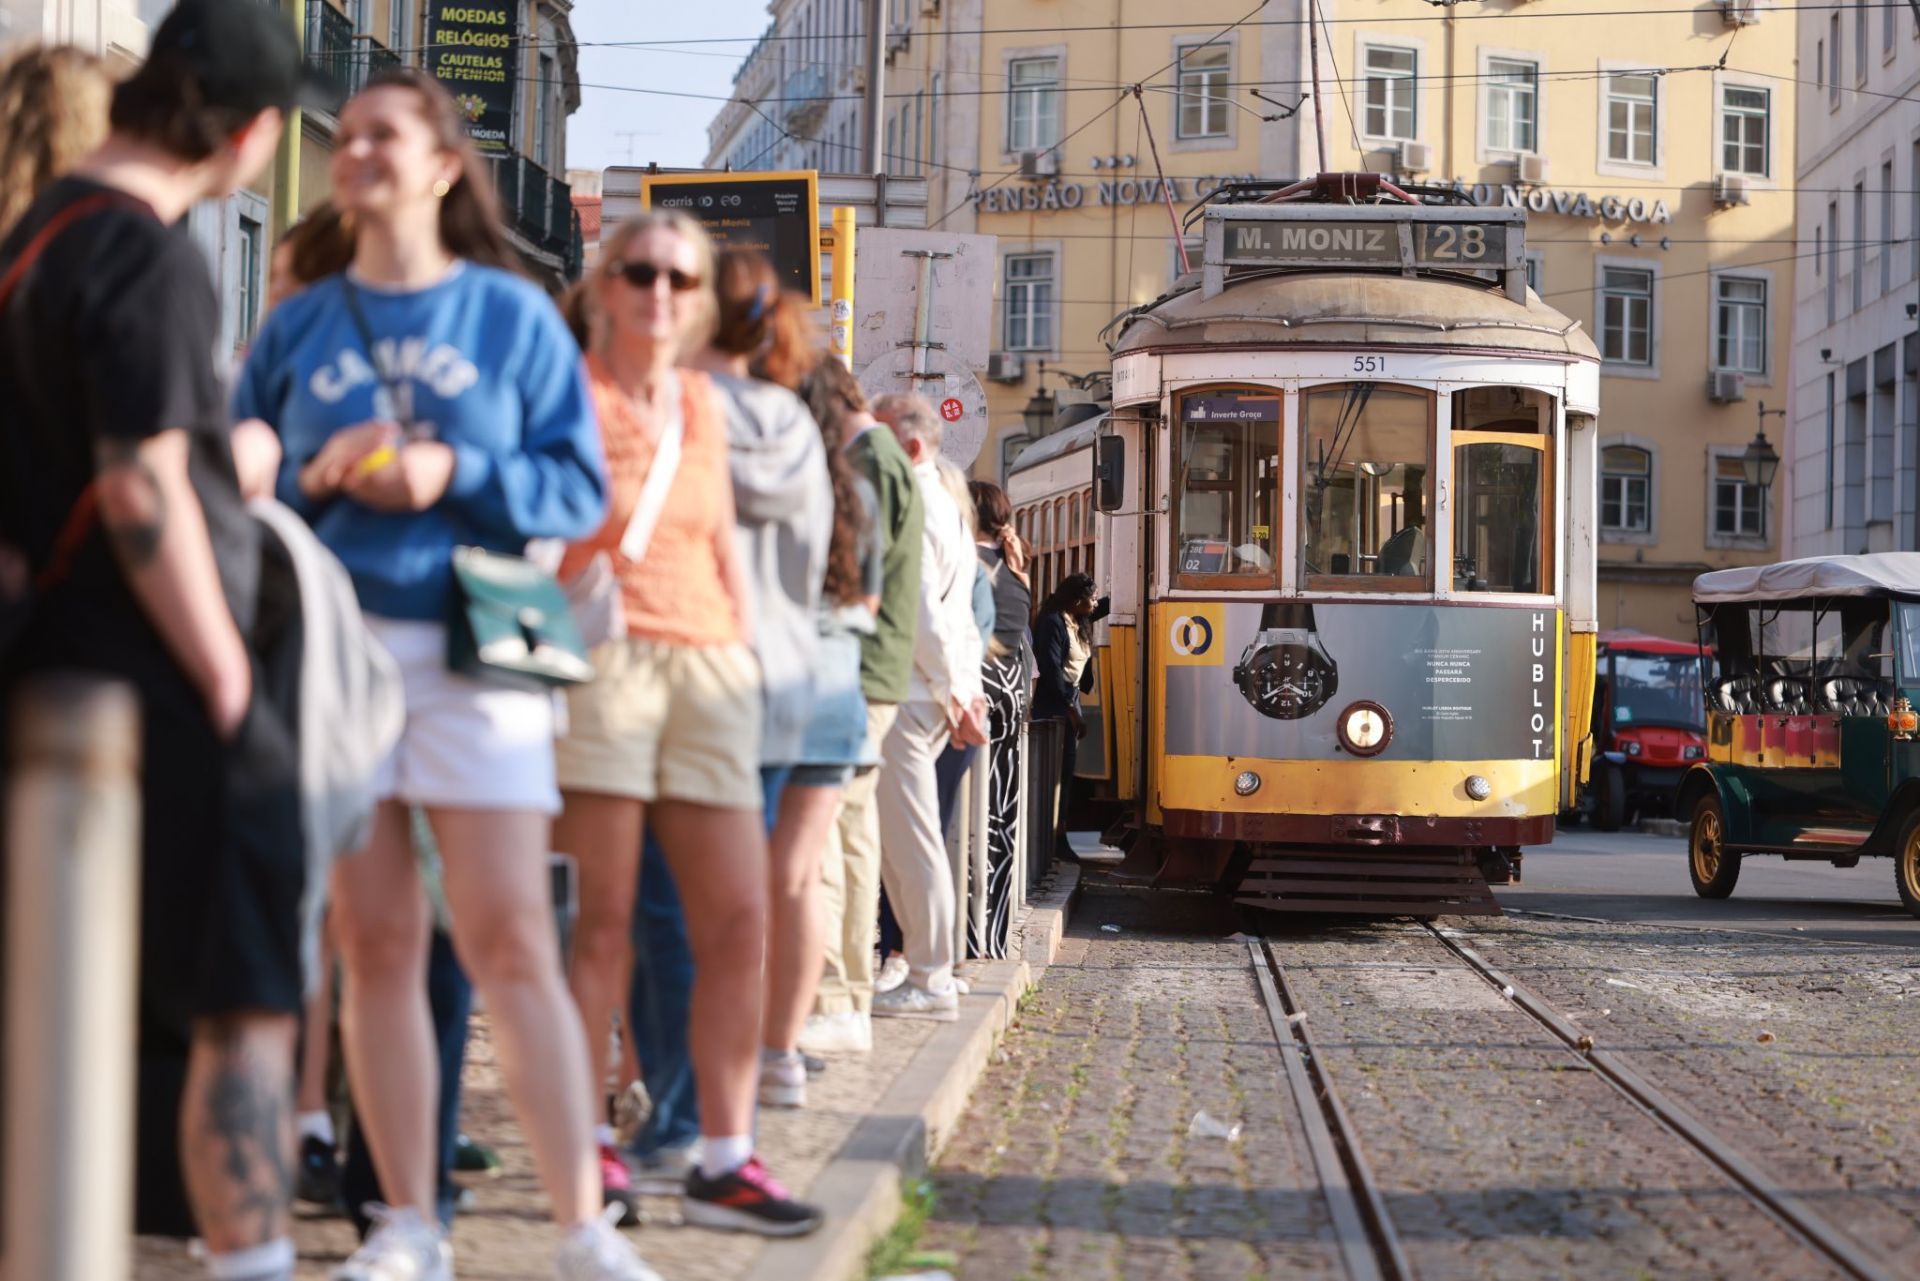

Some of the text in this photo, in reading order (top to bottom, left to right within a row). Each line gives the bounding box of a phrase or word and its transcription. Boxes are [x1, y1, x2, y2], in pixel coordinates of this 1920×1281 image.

[441, 7, 507, 25] MOEDAS
[436, 28, 509, 48] RELÓGIOS
[440, 53, 503, 69] CAUTELAS
[437, 67, 505, 82] DE PENHOR
[661, 195, 693, 208] carris
[971, 175, 1083, 214] PENSÃO
[1098, 178, 1181, 207] NOVA
[1500, 183, 1596, 217] NOVA
[1600, 195, 1673, 225] GOA
[1236, 227, 1386, 251] M. MONIZ
[1432, 224, 1486, 259] 28
[1353, 355, 1385, 372] 551
[1239, 410, 1262, 419] Graça
[1185, 559, 1200, 570] 02
[1531, 613, 1545, 759] HUBLOT
